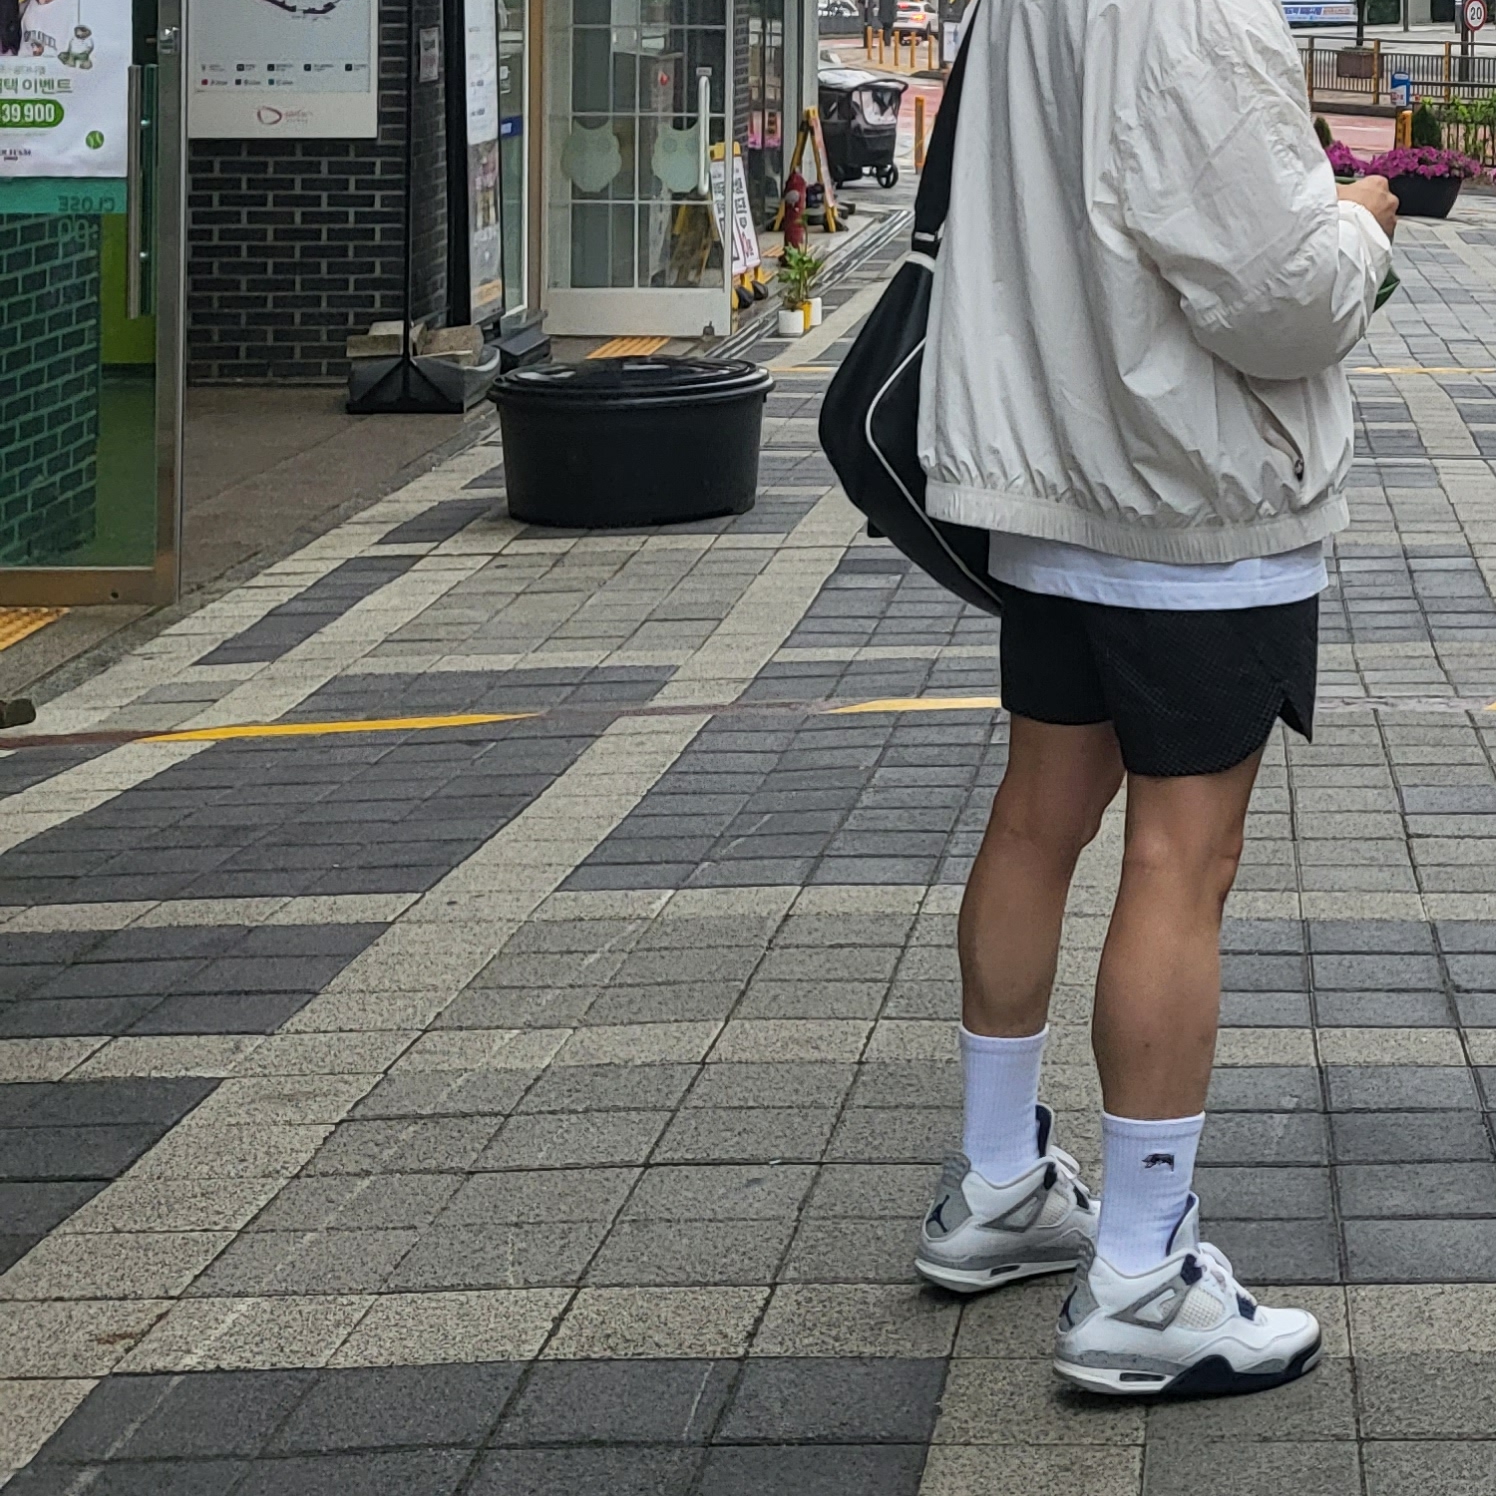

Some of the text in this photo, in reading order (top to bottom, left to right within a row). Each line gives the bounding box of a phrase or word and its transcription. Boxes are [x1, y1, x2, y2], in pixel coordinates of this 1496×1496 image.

[1470, 6, 1483, 21] 20
[0, 77, 73, 94] 택 이벤트
